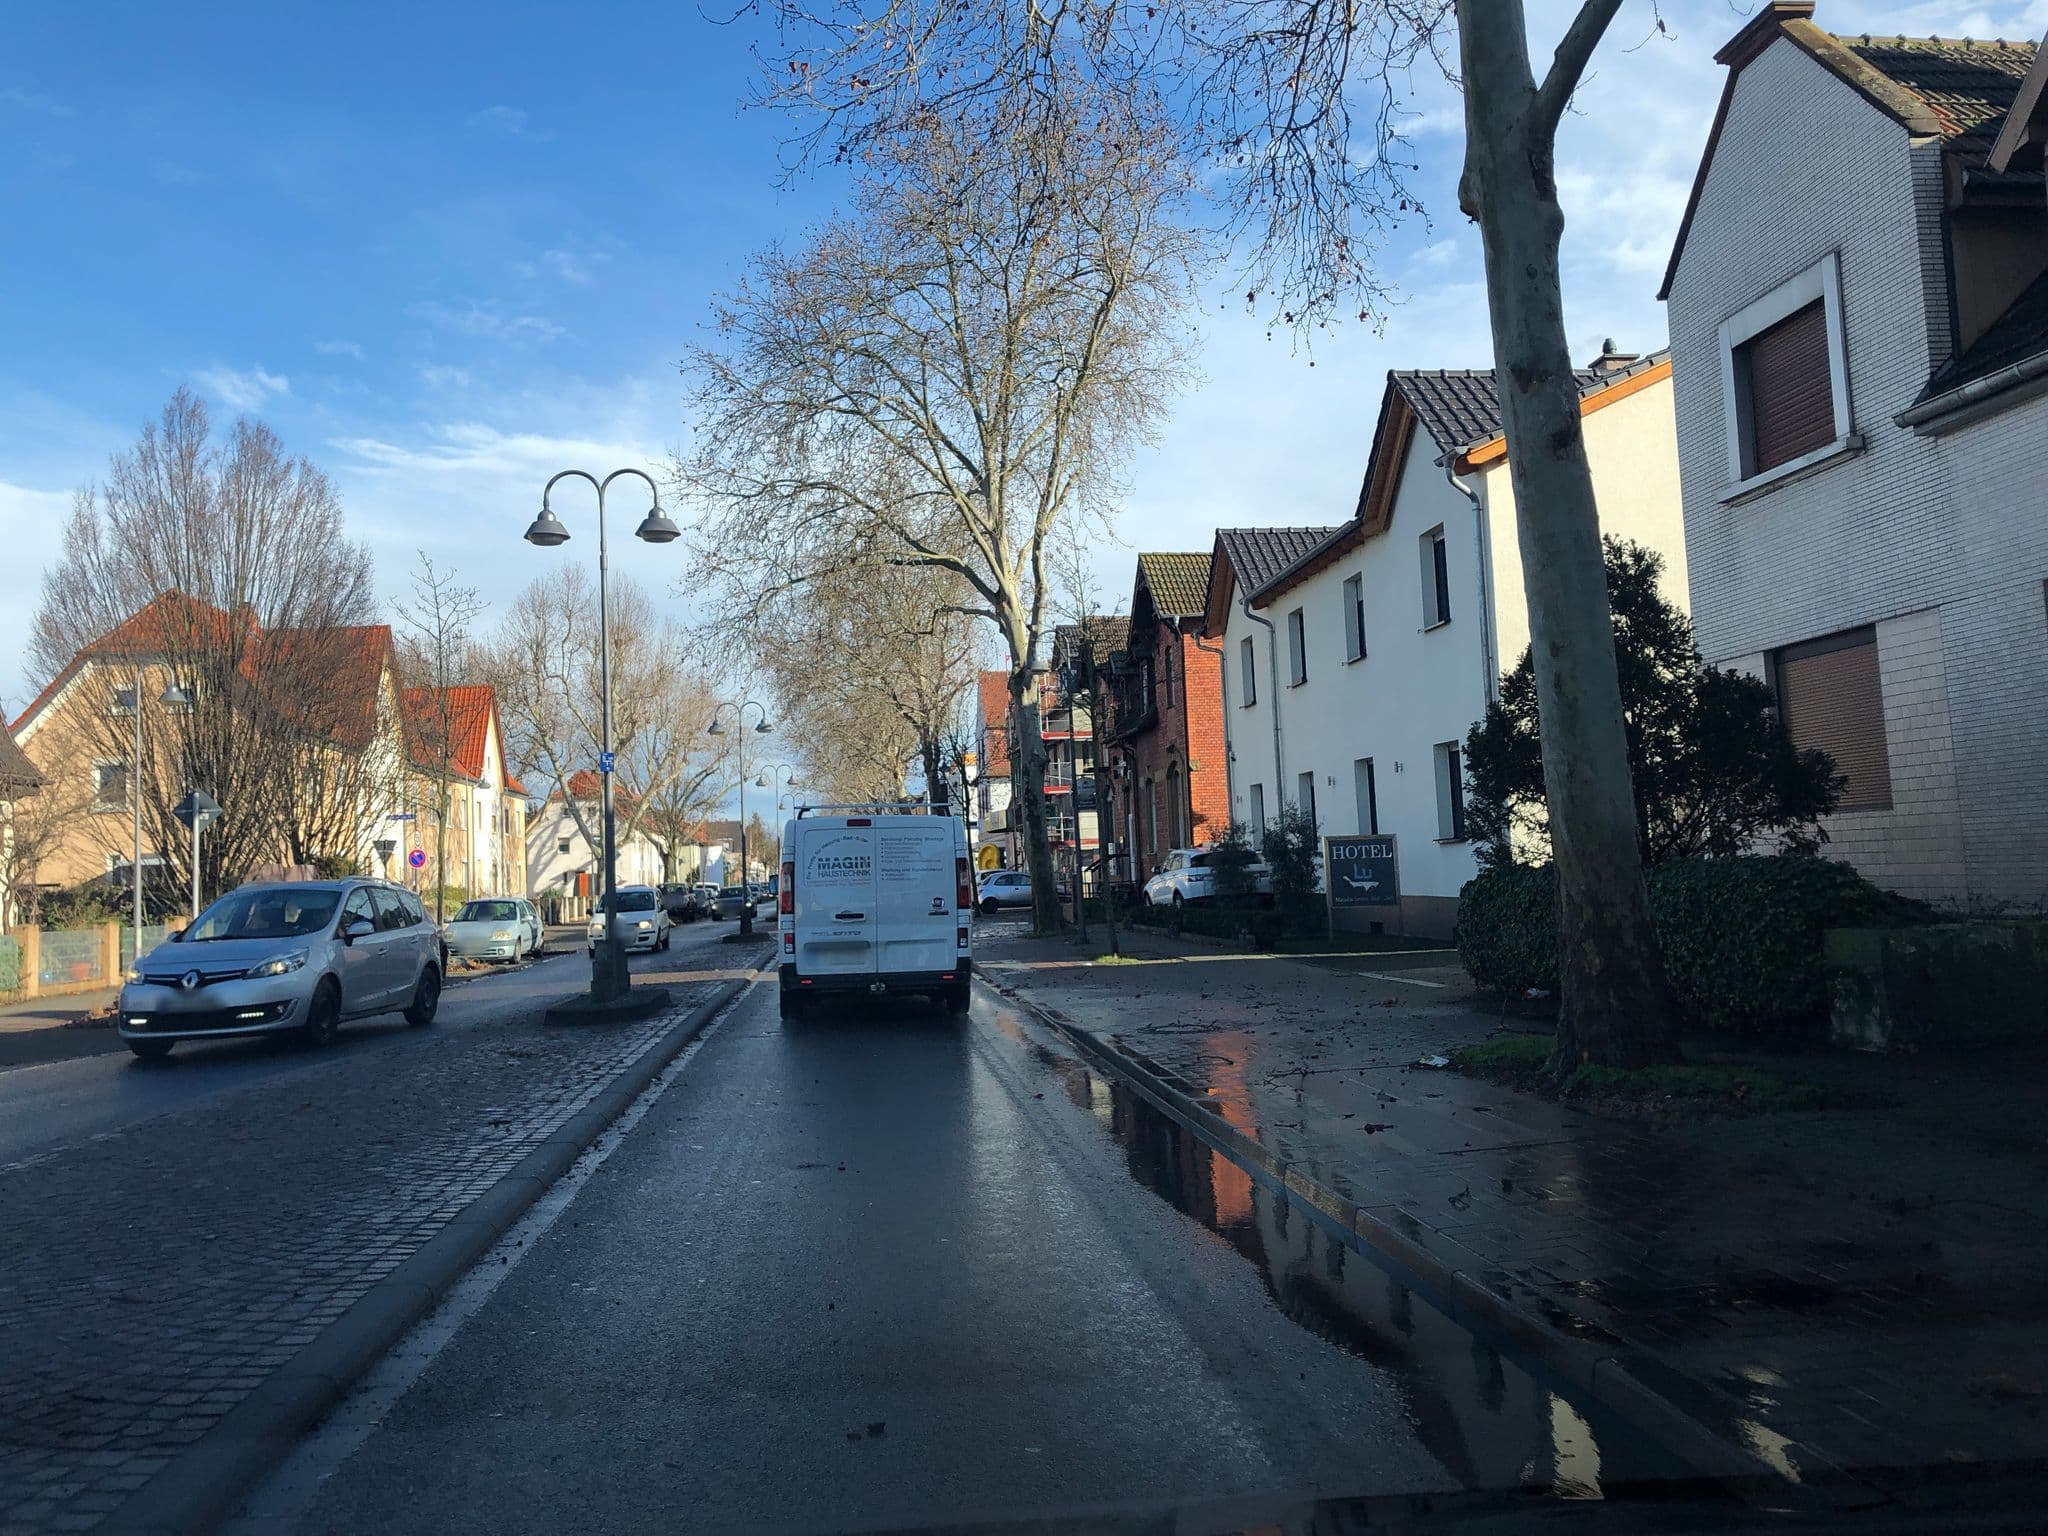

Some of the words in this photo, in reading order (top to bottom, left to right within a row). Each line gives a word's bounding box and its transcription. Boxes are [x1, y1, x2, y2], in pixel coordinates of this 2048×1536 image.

[1332, 845, 1392, 860] HOTEL
[818, 856, 871, 870] MAGIN
[818, 869, 871, 878] HAUSTECHNIK
